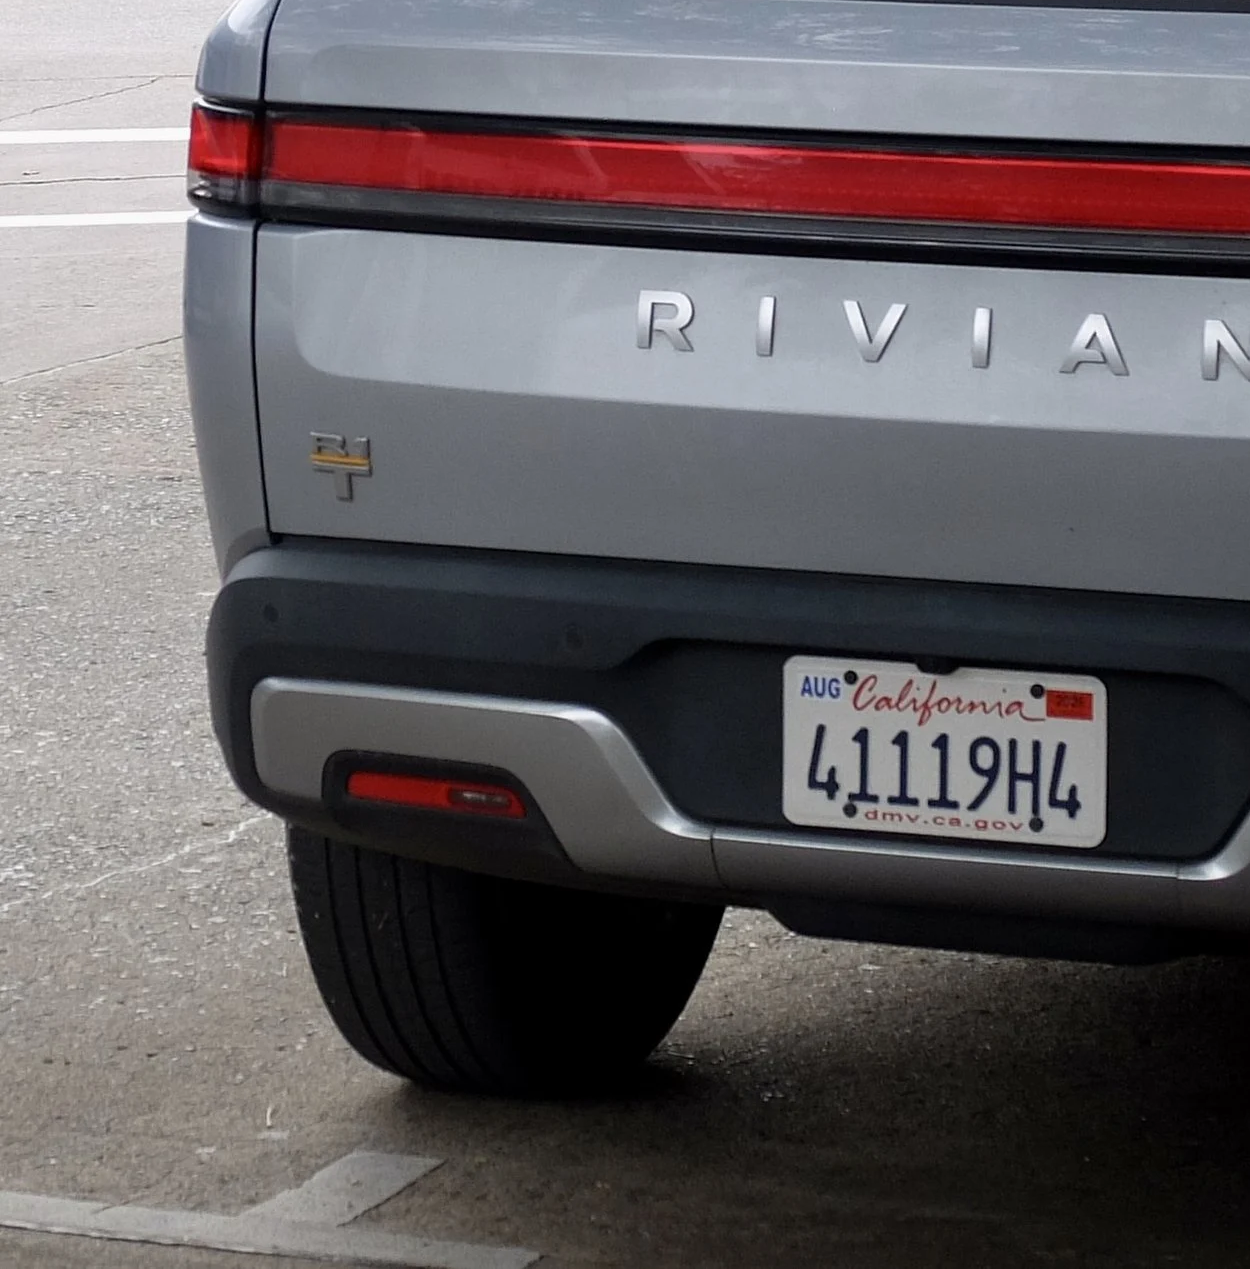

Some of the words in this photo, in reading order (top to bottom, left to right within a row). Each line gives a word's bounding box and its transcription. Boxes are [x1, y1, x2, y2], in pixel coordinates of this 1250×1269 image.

[801, 676, 841, 700] AUG
[852, 675, 1046, 726] California
[808, 724, 1082, 819] 41119H4
[865, 809, 1023, 831] dmv.ca.gov
